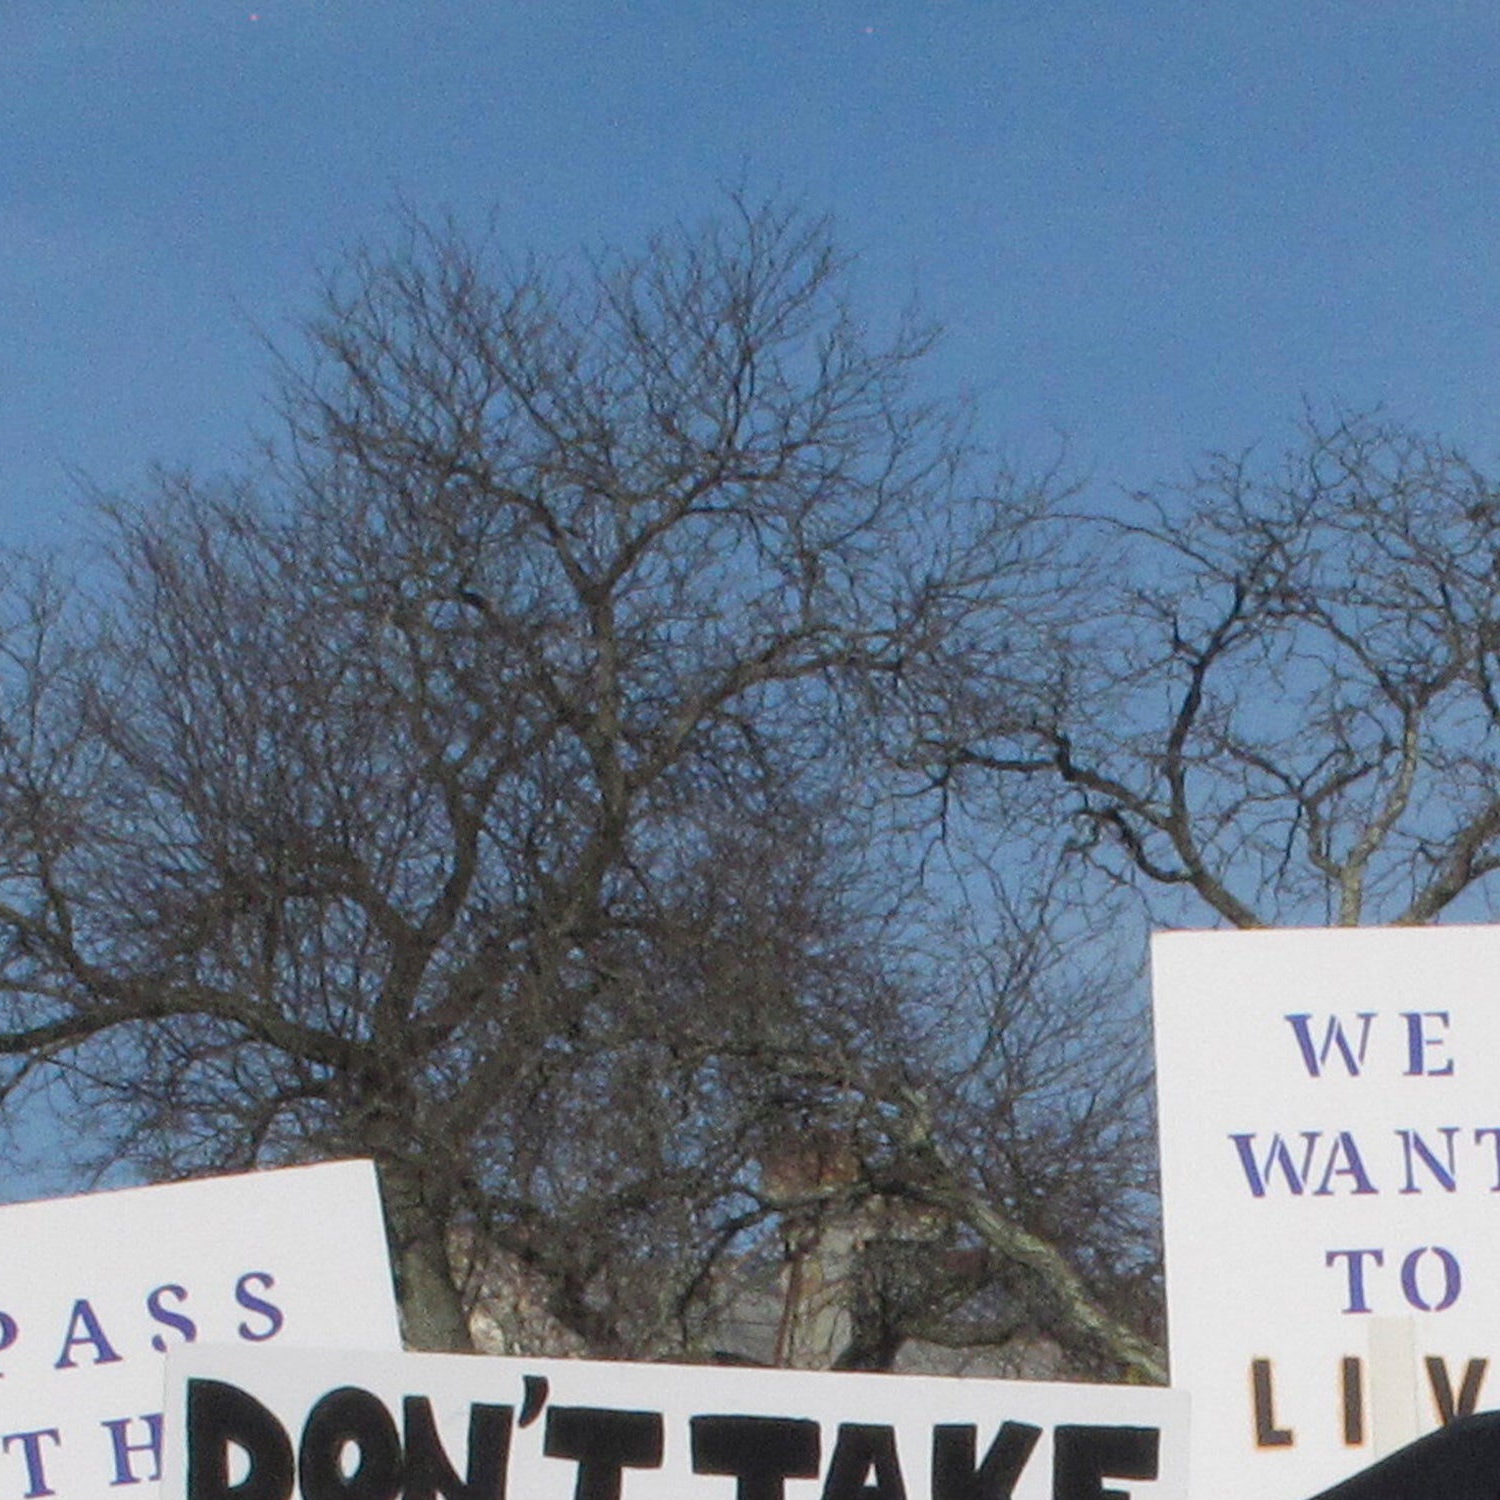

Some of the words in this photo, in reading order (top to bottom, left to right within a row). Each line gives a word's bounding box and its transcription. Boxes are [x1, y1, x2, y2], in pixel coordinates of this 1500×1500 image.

[1284, 1011, 1456, 1078] WE
[1325, 1246, 1463, 1316] TO
[3, 1412, 164, 1499] TH
